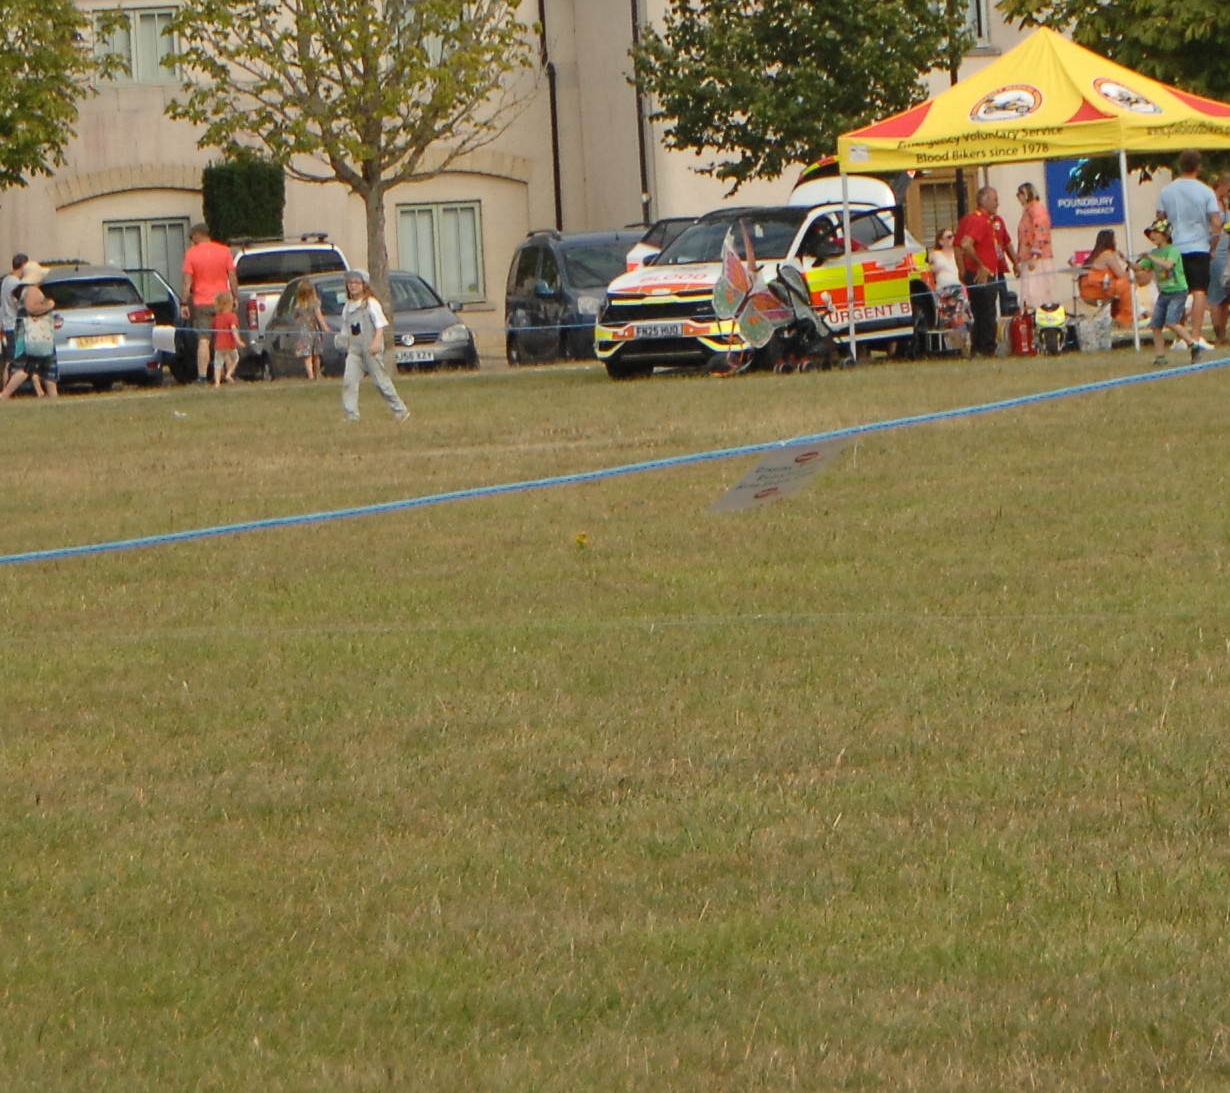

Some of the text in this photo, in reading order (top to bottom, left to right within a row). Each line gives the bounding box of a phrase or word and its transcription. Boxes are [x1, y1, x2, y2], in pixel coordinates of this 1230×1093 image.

[962, 128, 1019, 143] Voluntary
[1022, 126, 1064, 138] Service
[916, 142, 1049, 164] Blood Bikers since 1978
[1057, 195, 1115, 208] POUNDBURY
[829, 304, 894, 323] URGENT
